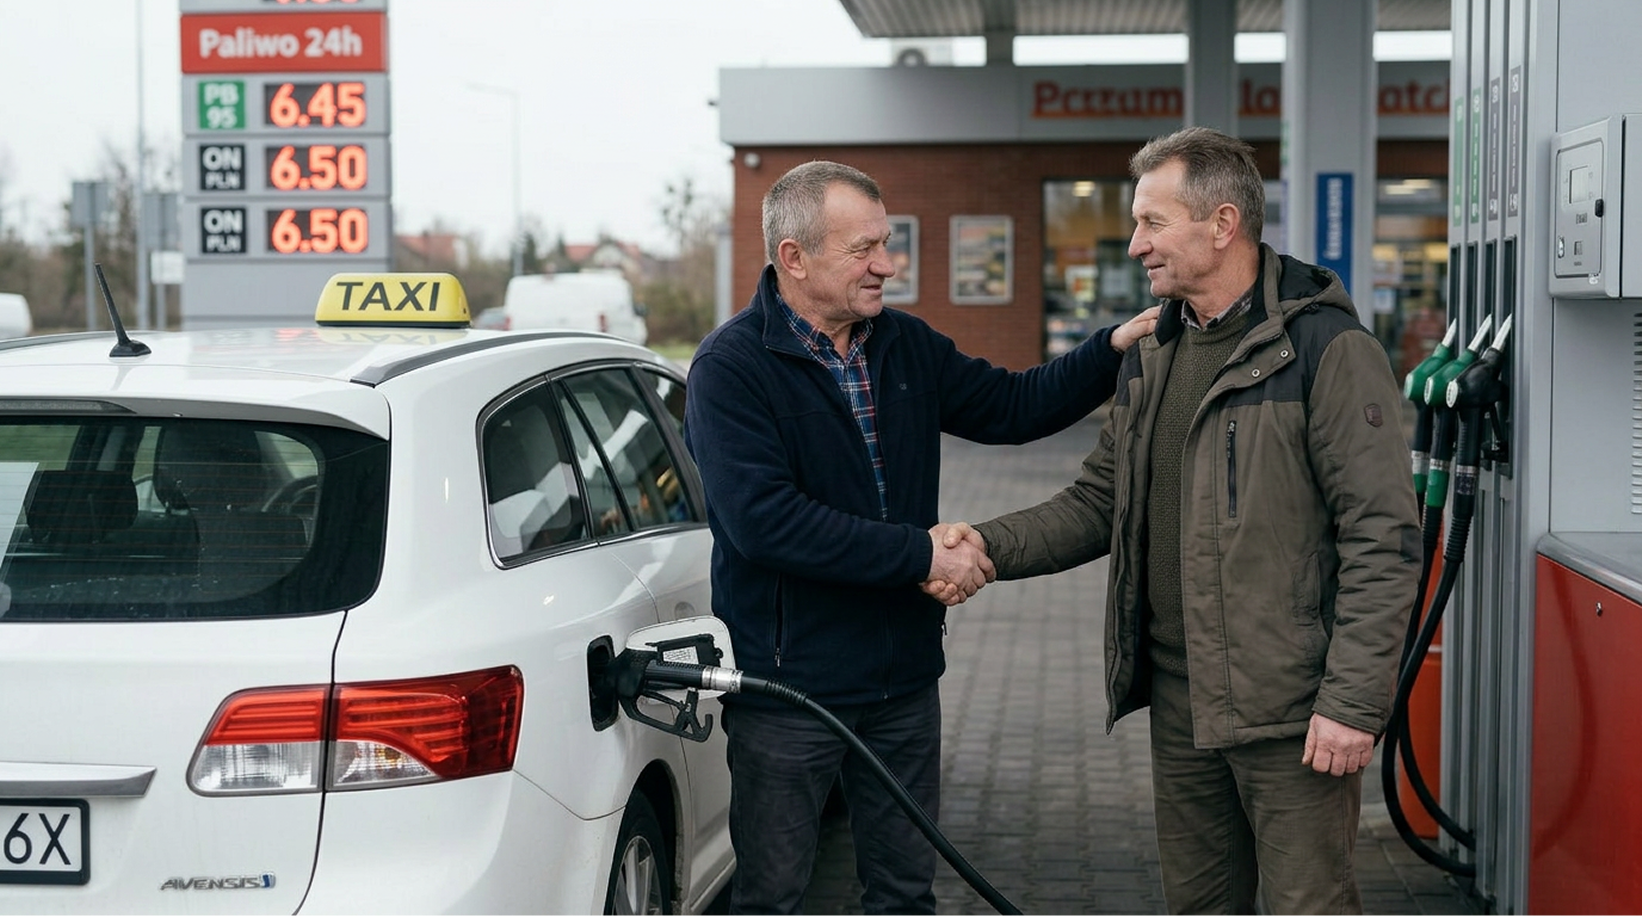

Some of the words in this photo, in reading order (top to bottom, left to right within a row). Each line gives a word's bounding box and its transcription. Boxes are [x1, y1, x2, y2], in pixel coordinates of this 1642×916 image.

[200, 26, 300, 58] Paliwo
[304, 25, 363, 57] 24h
[204, 83, 240, 105] PB
[270, 82, 367, 128] 6.45
[206, 106, 238, 128] 95
[203, 147, 242, 171] ON
[271, 145, 368, 191] 6.50
[206, 171, 240, 189] PLN
[204, 209, 243, 233] ON
[272, 208, 369, 254] 6.50
[207, 234, 241, 252] PLN
[336, 281, 441, 311] TAXI
[3, 812, 71, 865] 6X
[160, 877, 260, 891] AVENSIS
